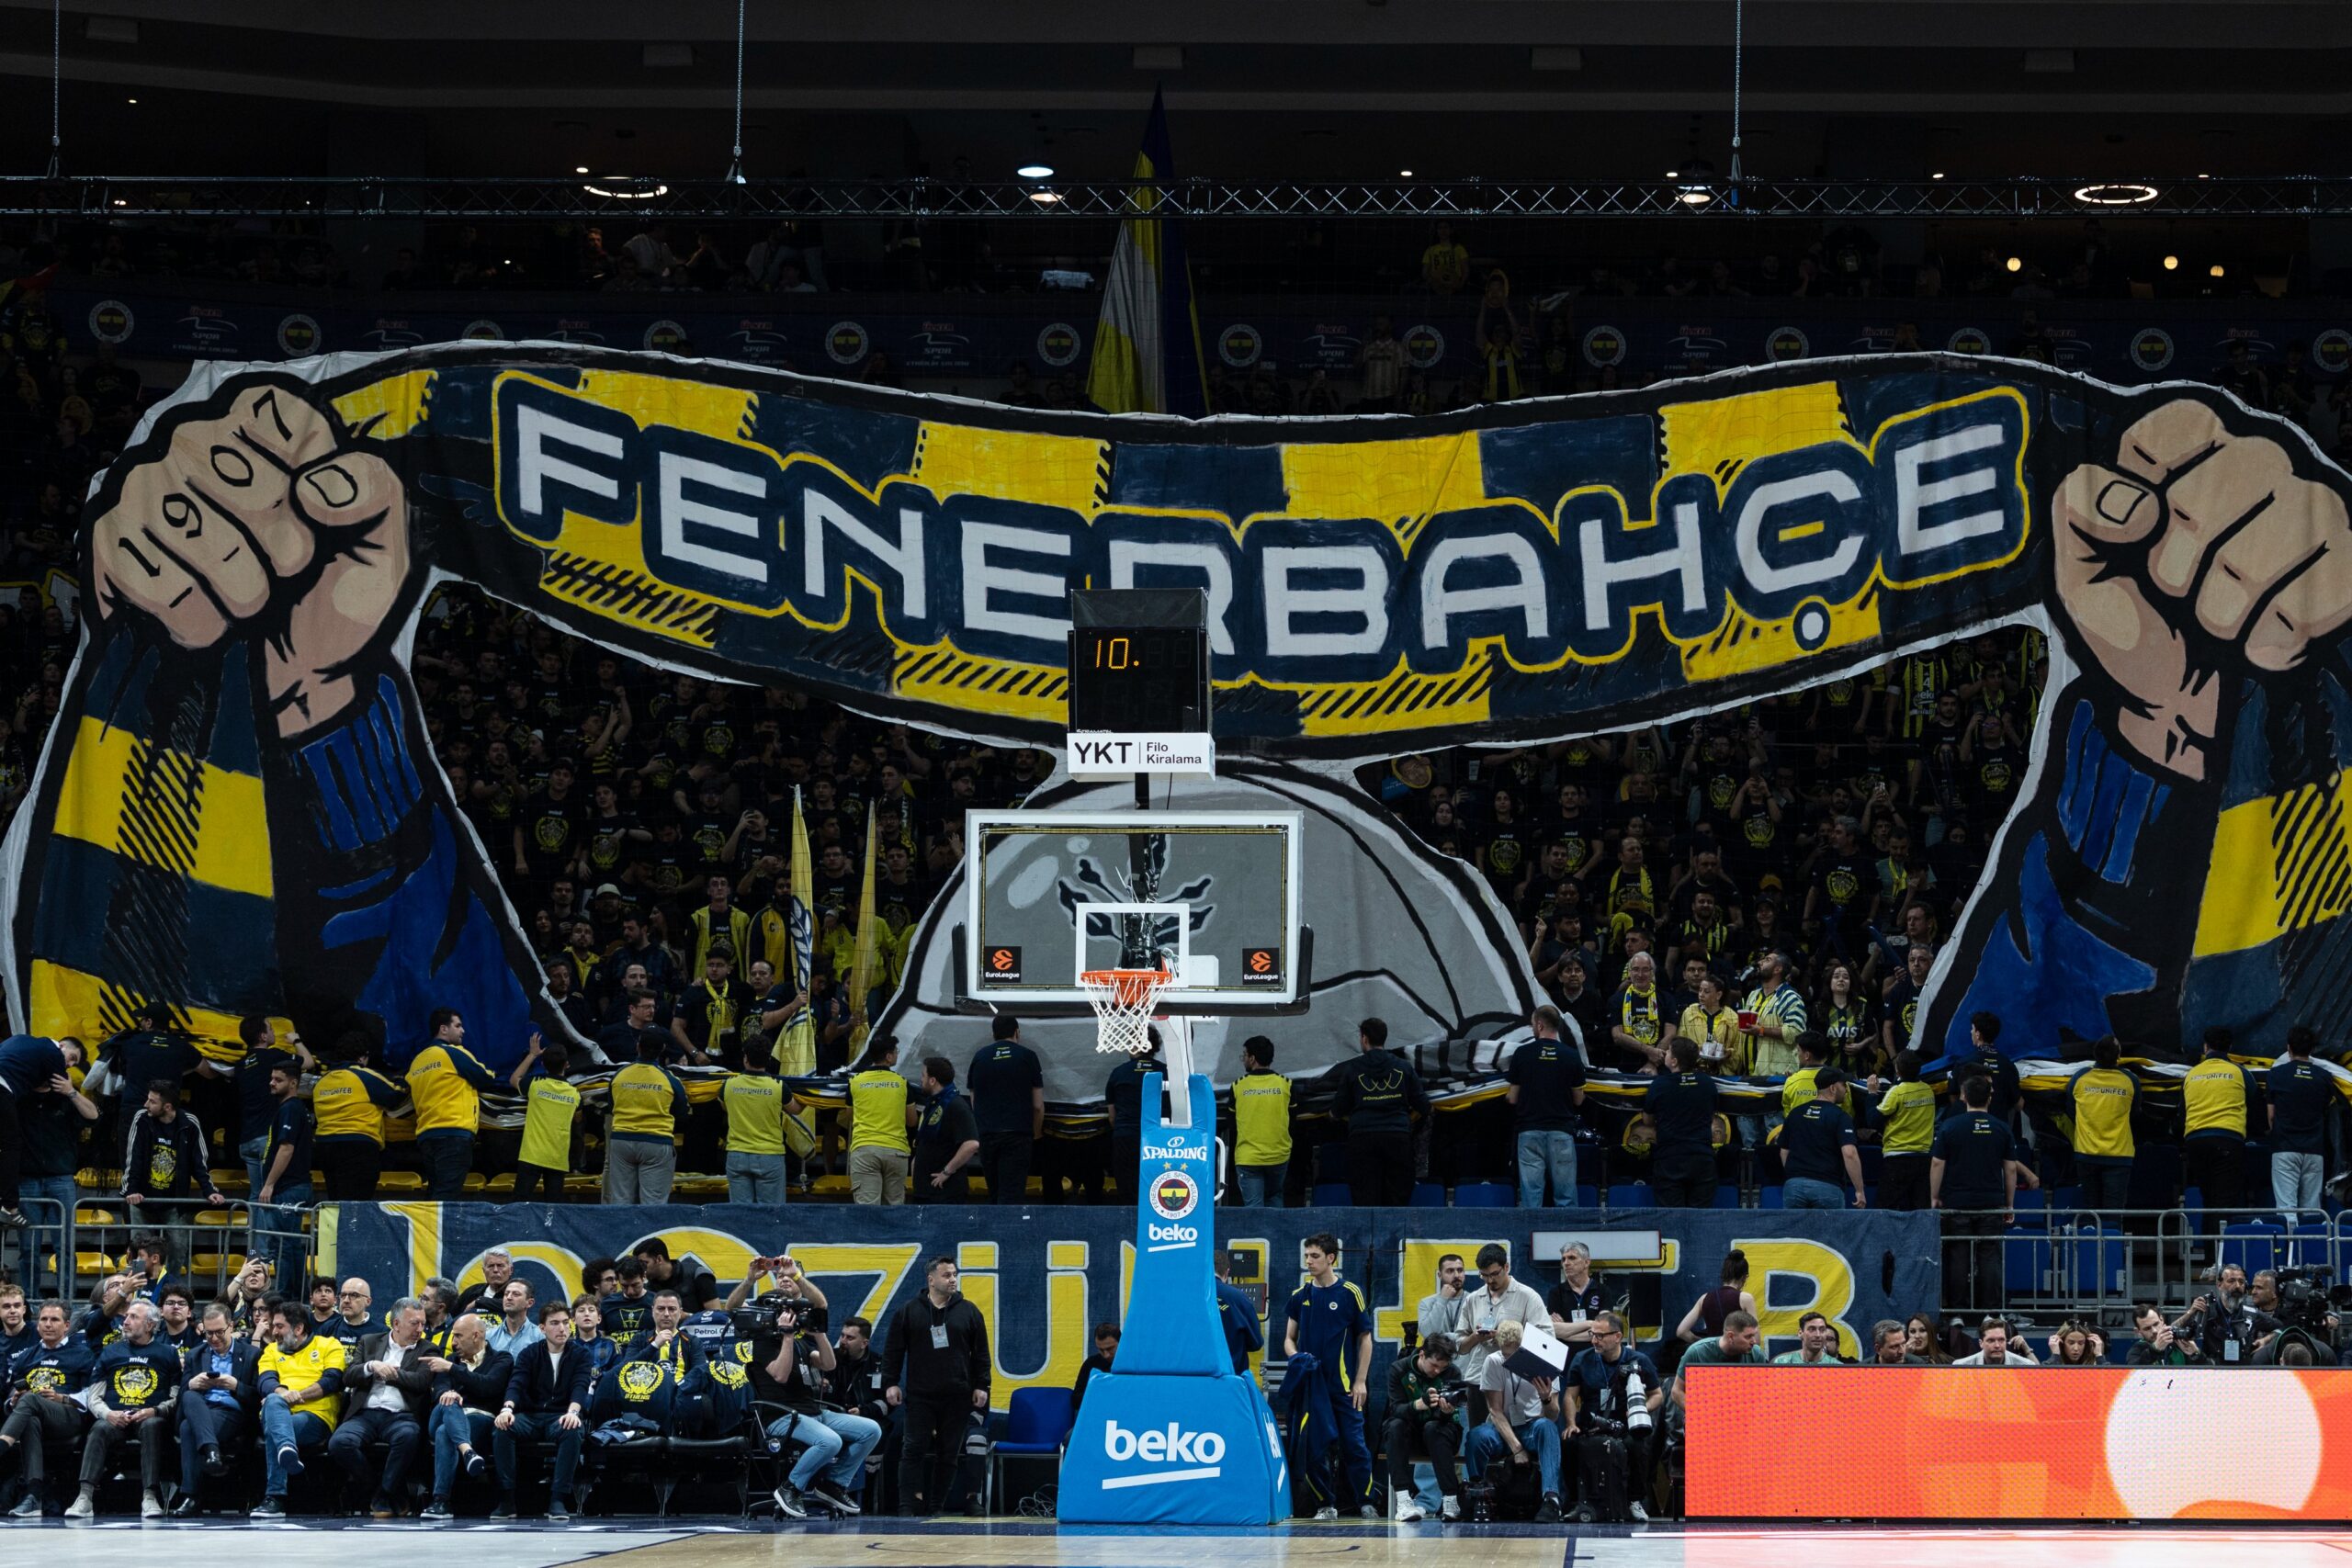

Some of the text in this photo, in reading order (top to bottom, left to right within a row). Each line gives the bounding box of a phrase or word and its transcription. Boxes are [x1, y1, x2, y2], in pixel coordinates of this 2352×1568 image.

[192, 332, 220, 340] SPOR
[742, 344, 771, 353] SPOR
[119, 389, 293, 577] 1907
[517, 403, 2004, 656] FENERBAHÇE
[1074, 741, 1133, 764] YKT
[1147, 742, 1169, 752] Filo
[1147, 754, 1202, 764] Kiralama
[985, 971, 1020, 979] EuroLeague
[1243, 973, 1279, 981] EuroLeague
[1826, 1027, 1859, 1039] AVIS
[1143, 1145, 1207, 1162] SPALDING
[1148, 1223, 1198, 1241] beko
[694, 1327, 718, 1336] Petrol
[1105, 1419, 1226, 1463] beko
